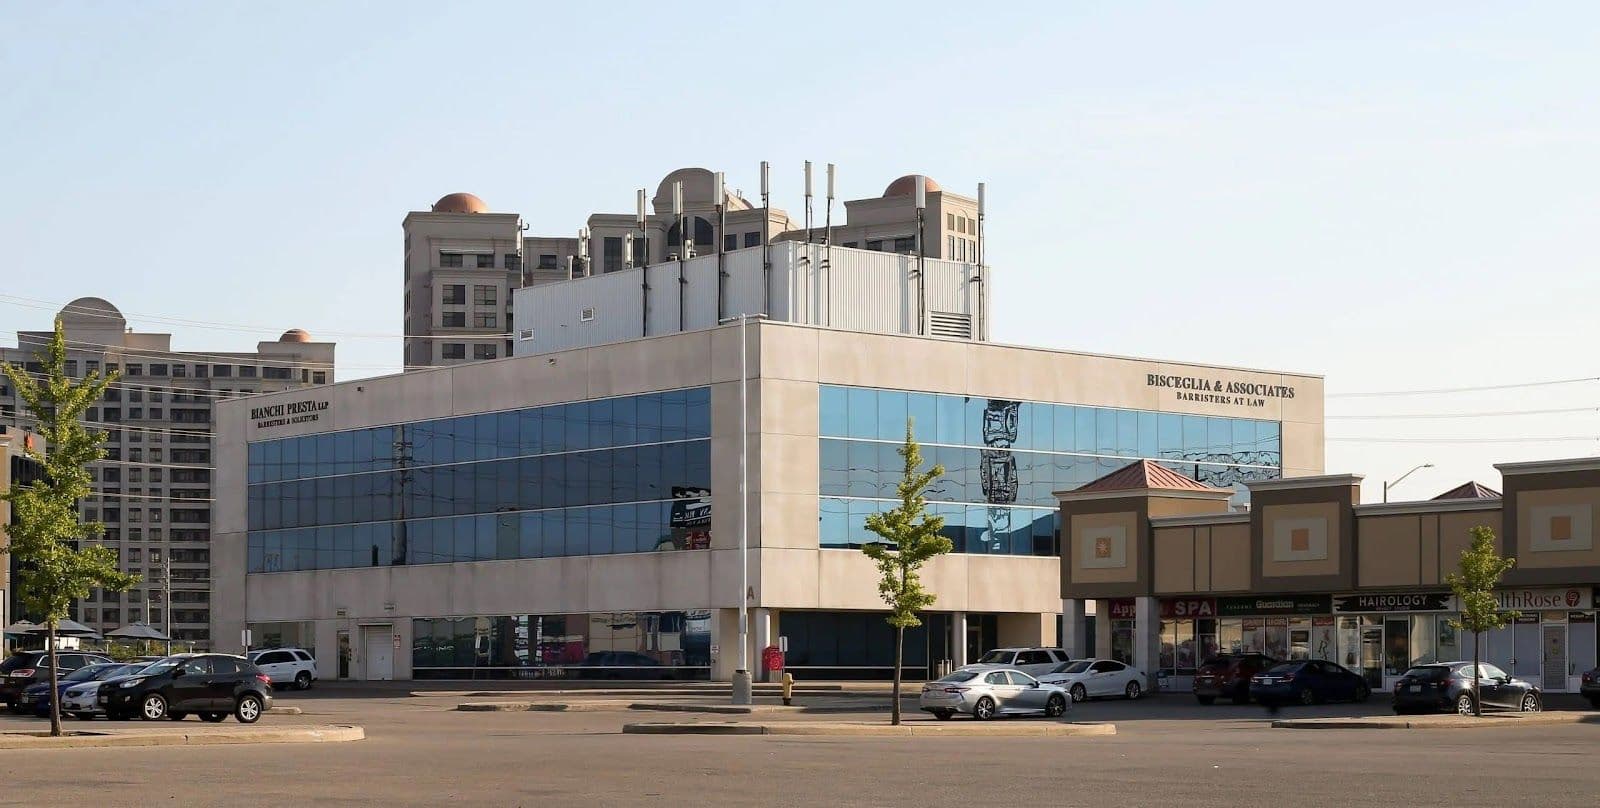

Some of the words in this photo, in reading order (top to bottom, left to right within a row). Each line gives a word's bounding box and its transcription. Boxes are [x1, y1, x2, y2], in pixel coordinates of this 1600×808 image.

[1147, 374, 1211, 391] BISCEGLIA
[1213, 380, 1223, 392] &
[1226, 381, 1295, 399] ASSOCIATES
[1176, 391, 1231, 404] BARRISTERS
[1234, 397, 1244, 406] AT
[1247, 398, 1265, 407] LAW
[251, 405, 284, 420] BIANCHI
[287, 401, 317, 415] PRESTA
[318, 401, 329, 411] LLP
[257, 419, 286, 428] BARRISTERS
[746, 586, 755, 600] A
[1359, 595, 1428, 607] HAIROLOGY
[1497, 591, 1561, 608] lthRose
[1112, 603, 1136, 617] App
[1175, 600, 1212, 616] SPA
